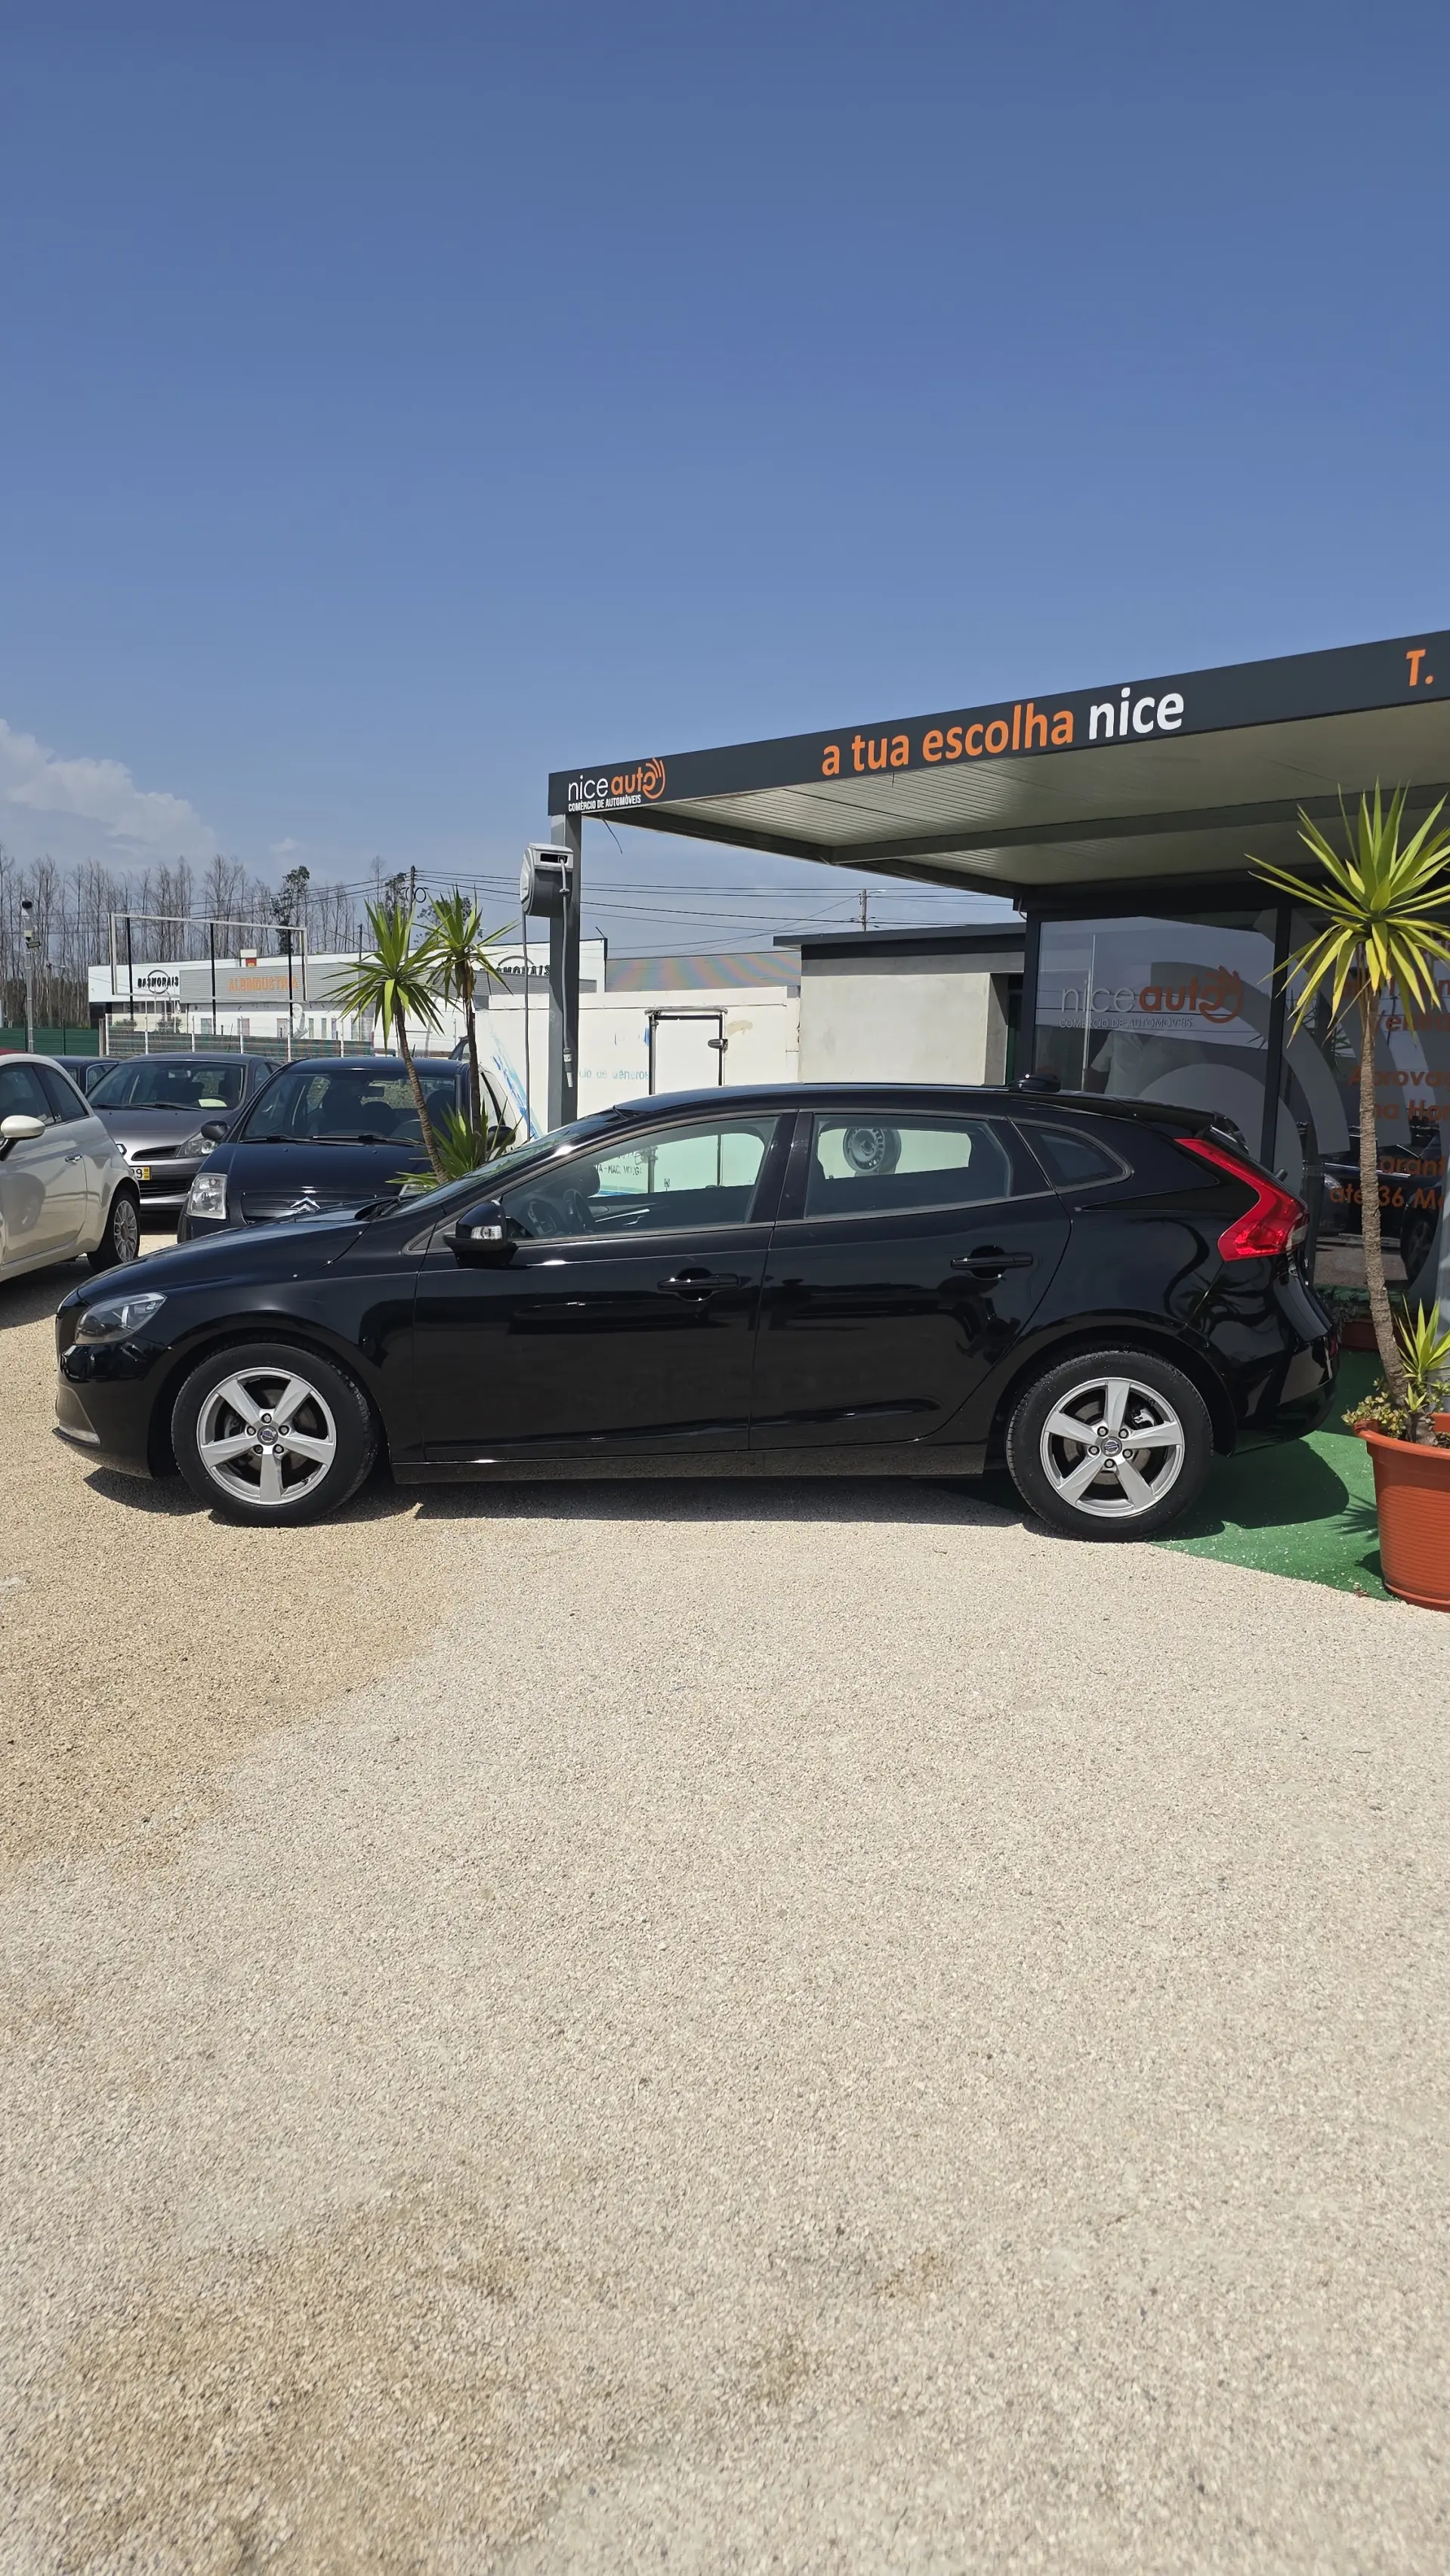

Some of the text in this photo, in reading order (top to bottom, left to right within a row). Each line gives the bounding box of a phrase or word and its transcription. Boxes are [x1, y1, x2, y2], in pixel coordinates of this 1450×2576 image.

[1406, 649, 1433, 686] T.
[822, 687, 1184, 776] a tua escolha nice
[597, 801, 604, 809] DE
